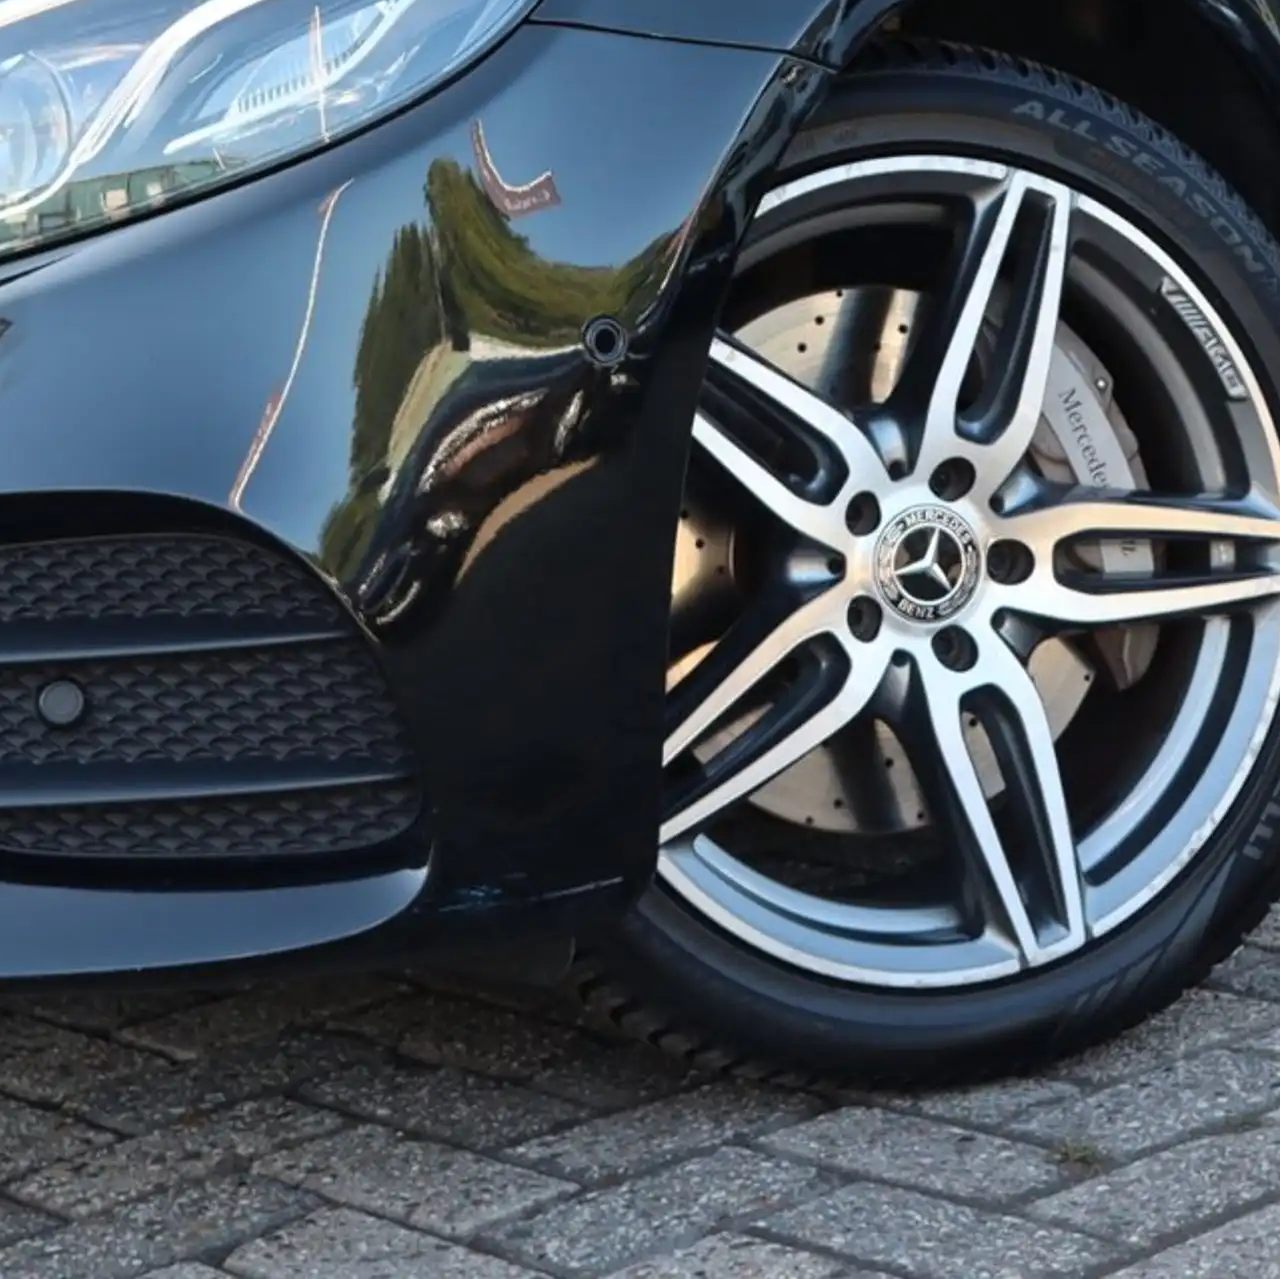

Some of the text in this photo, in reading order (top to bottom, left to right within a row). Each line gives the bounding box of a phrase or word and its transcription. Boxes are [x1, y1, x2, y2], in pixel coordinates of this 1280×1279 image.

[1012, 100, 1098, 142] ALL
[1104, 135, 1266, 274] SEASON
[897, 597, 937, 619] BENZ
